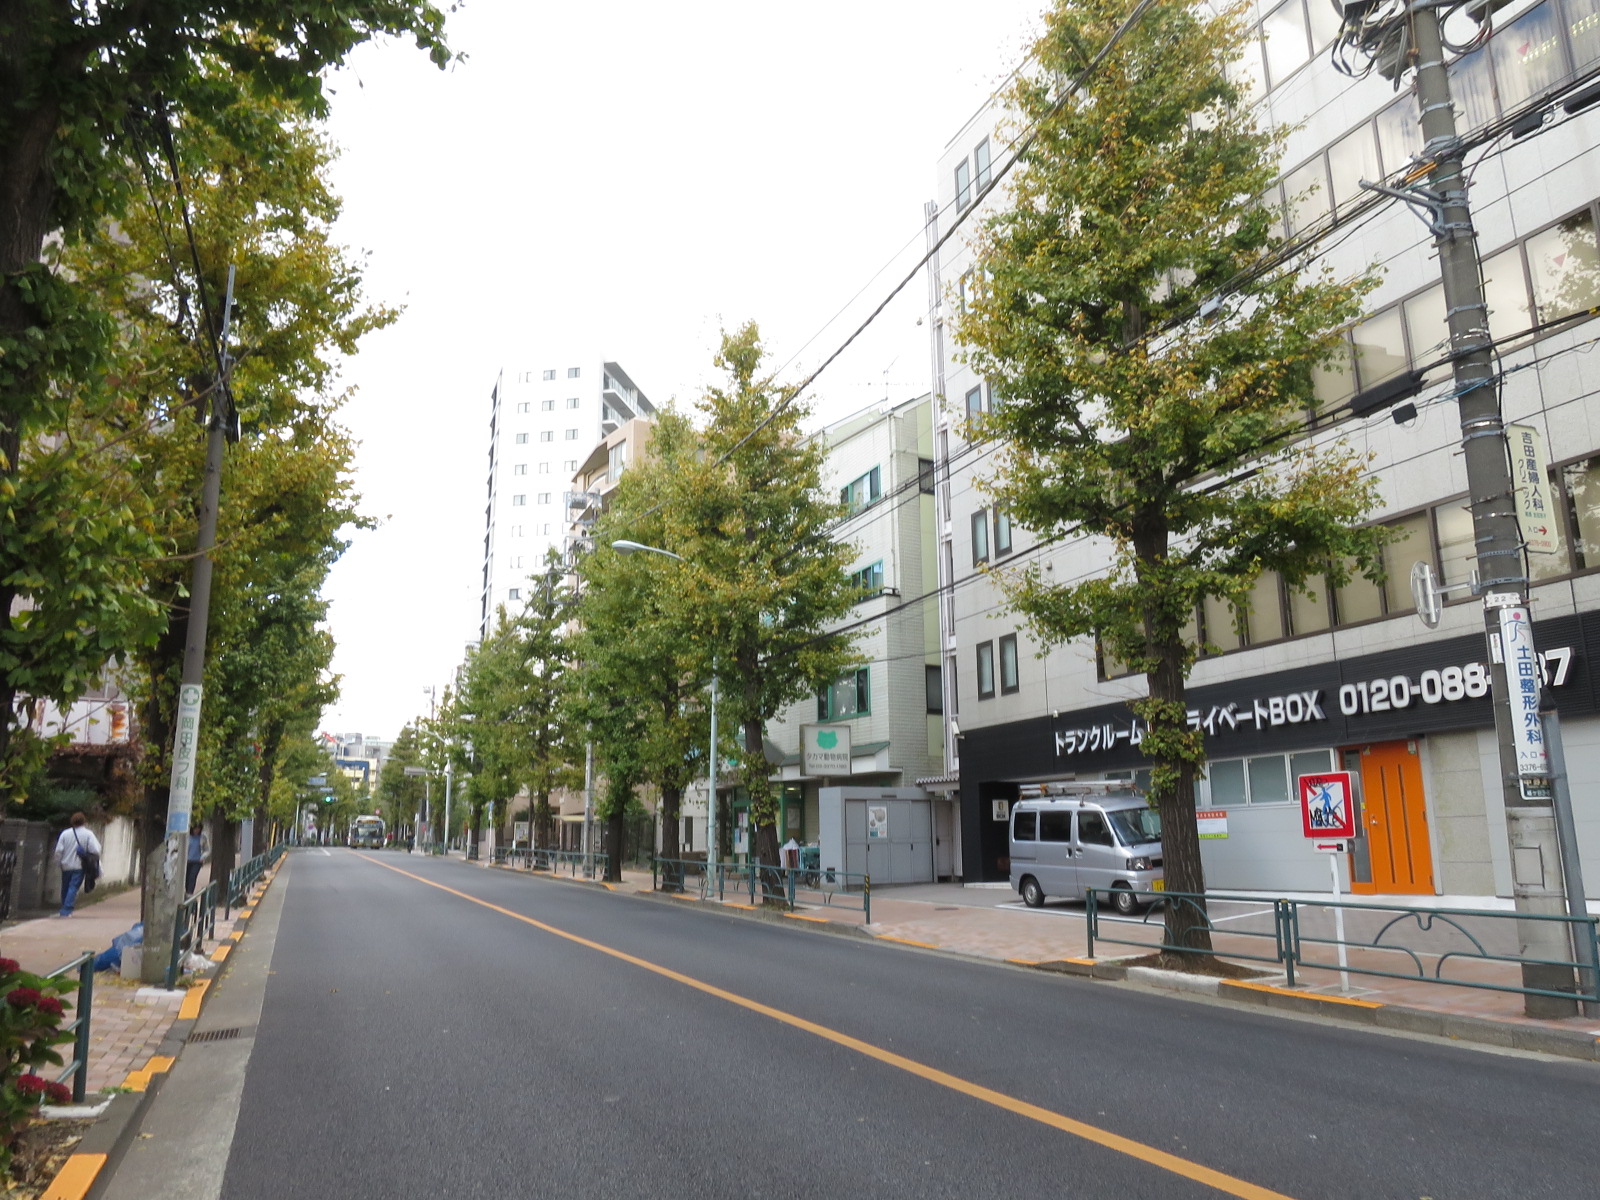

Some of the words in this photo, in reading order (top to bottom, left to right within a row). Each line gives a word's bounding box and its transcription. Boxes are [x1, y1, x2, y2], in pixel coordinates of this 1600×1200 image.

[1518, 459, 1531, 511] クリニック
[1521, 432, 1544, 512] 吉田産婦人科
[1527, 526, 1539, 534] 入口
[1054, 719, 1144, 757] トランクルーム
[1186, 689, 1325, 736] ライベートBOX
[1517, 645, 1542, 745] 土田整形外科
[175, 717, 194, 790] 岡田皮フ科
[806, 753, 849, 761] タカマ動物病院
[1520, 751, 1538, 759] 入口
